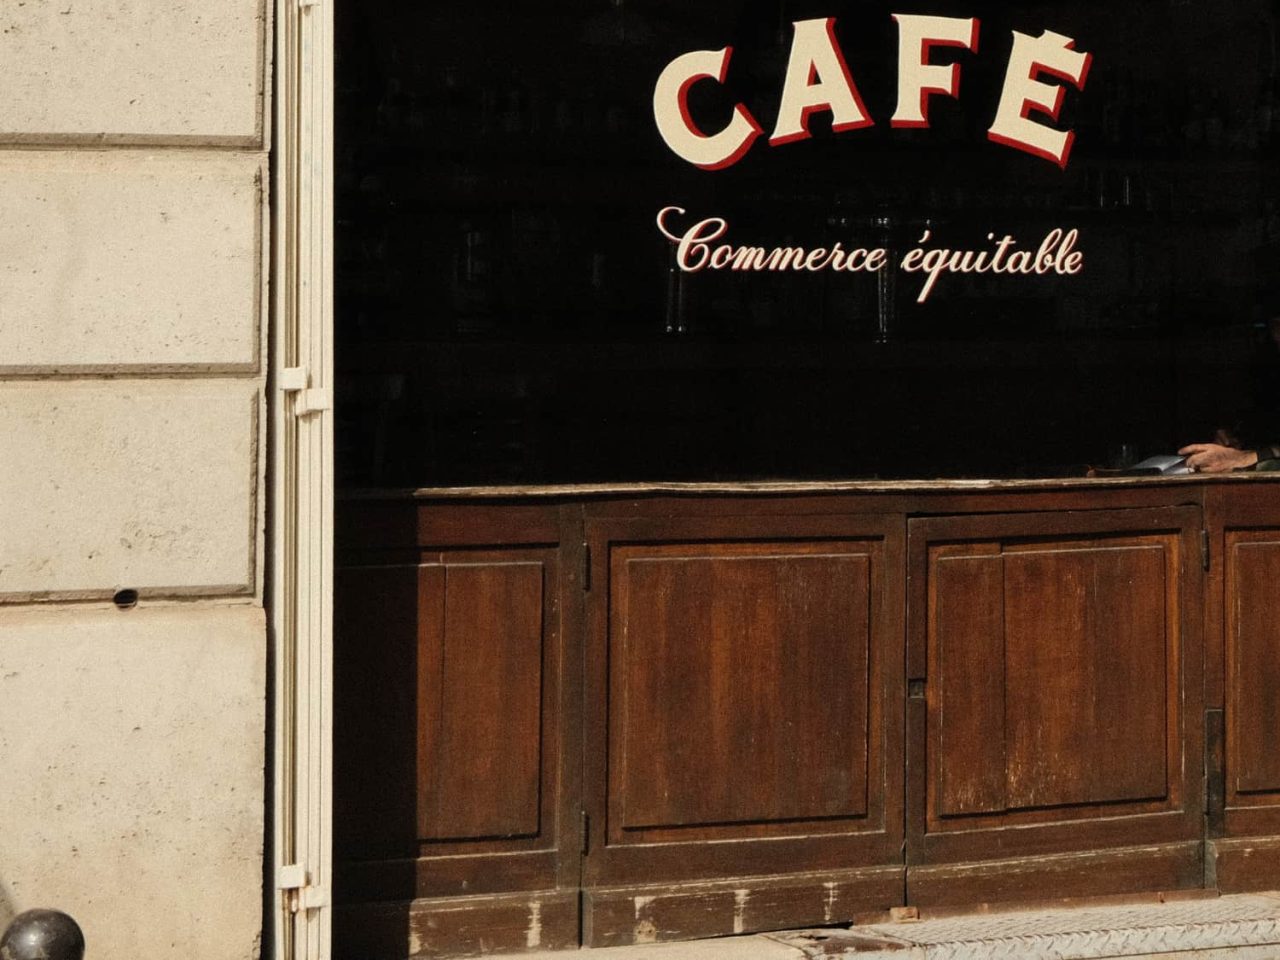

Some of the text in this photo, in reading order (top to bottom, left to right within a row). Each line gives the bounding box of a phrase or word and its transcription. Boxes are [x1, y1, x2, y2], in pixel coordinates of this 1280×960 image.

[653, 13, 1093, 171] CAFÉ
[656, 206, 1083, 304] Commerce équitable
